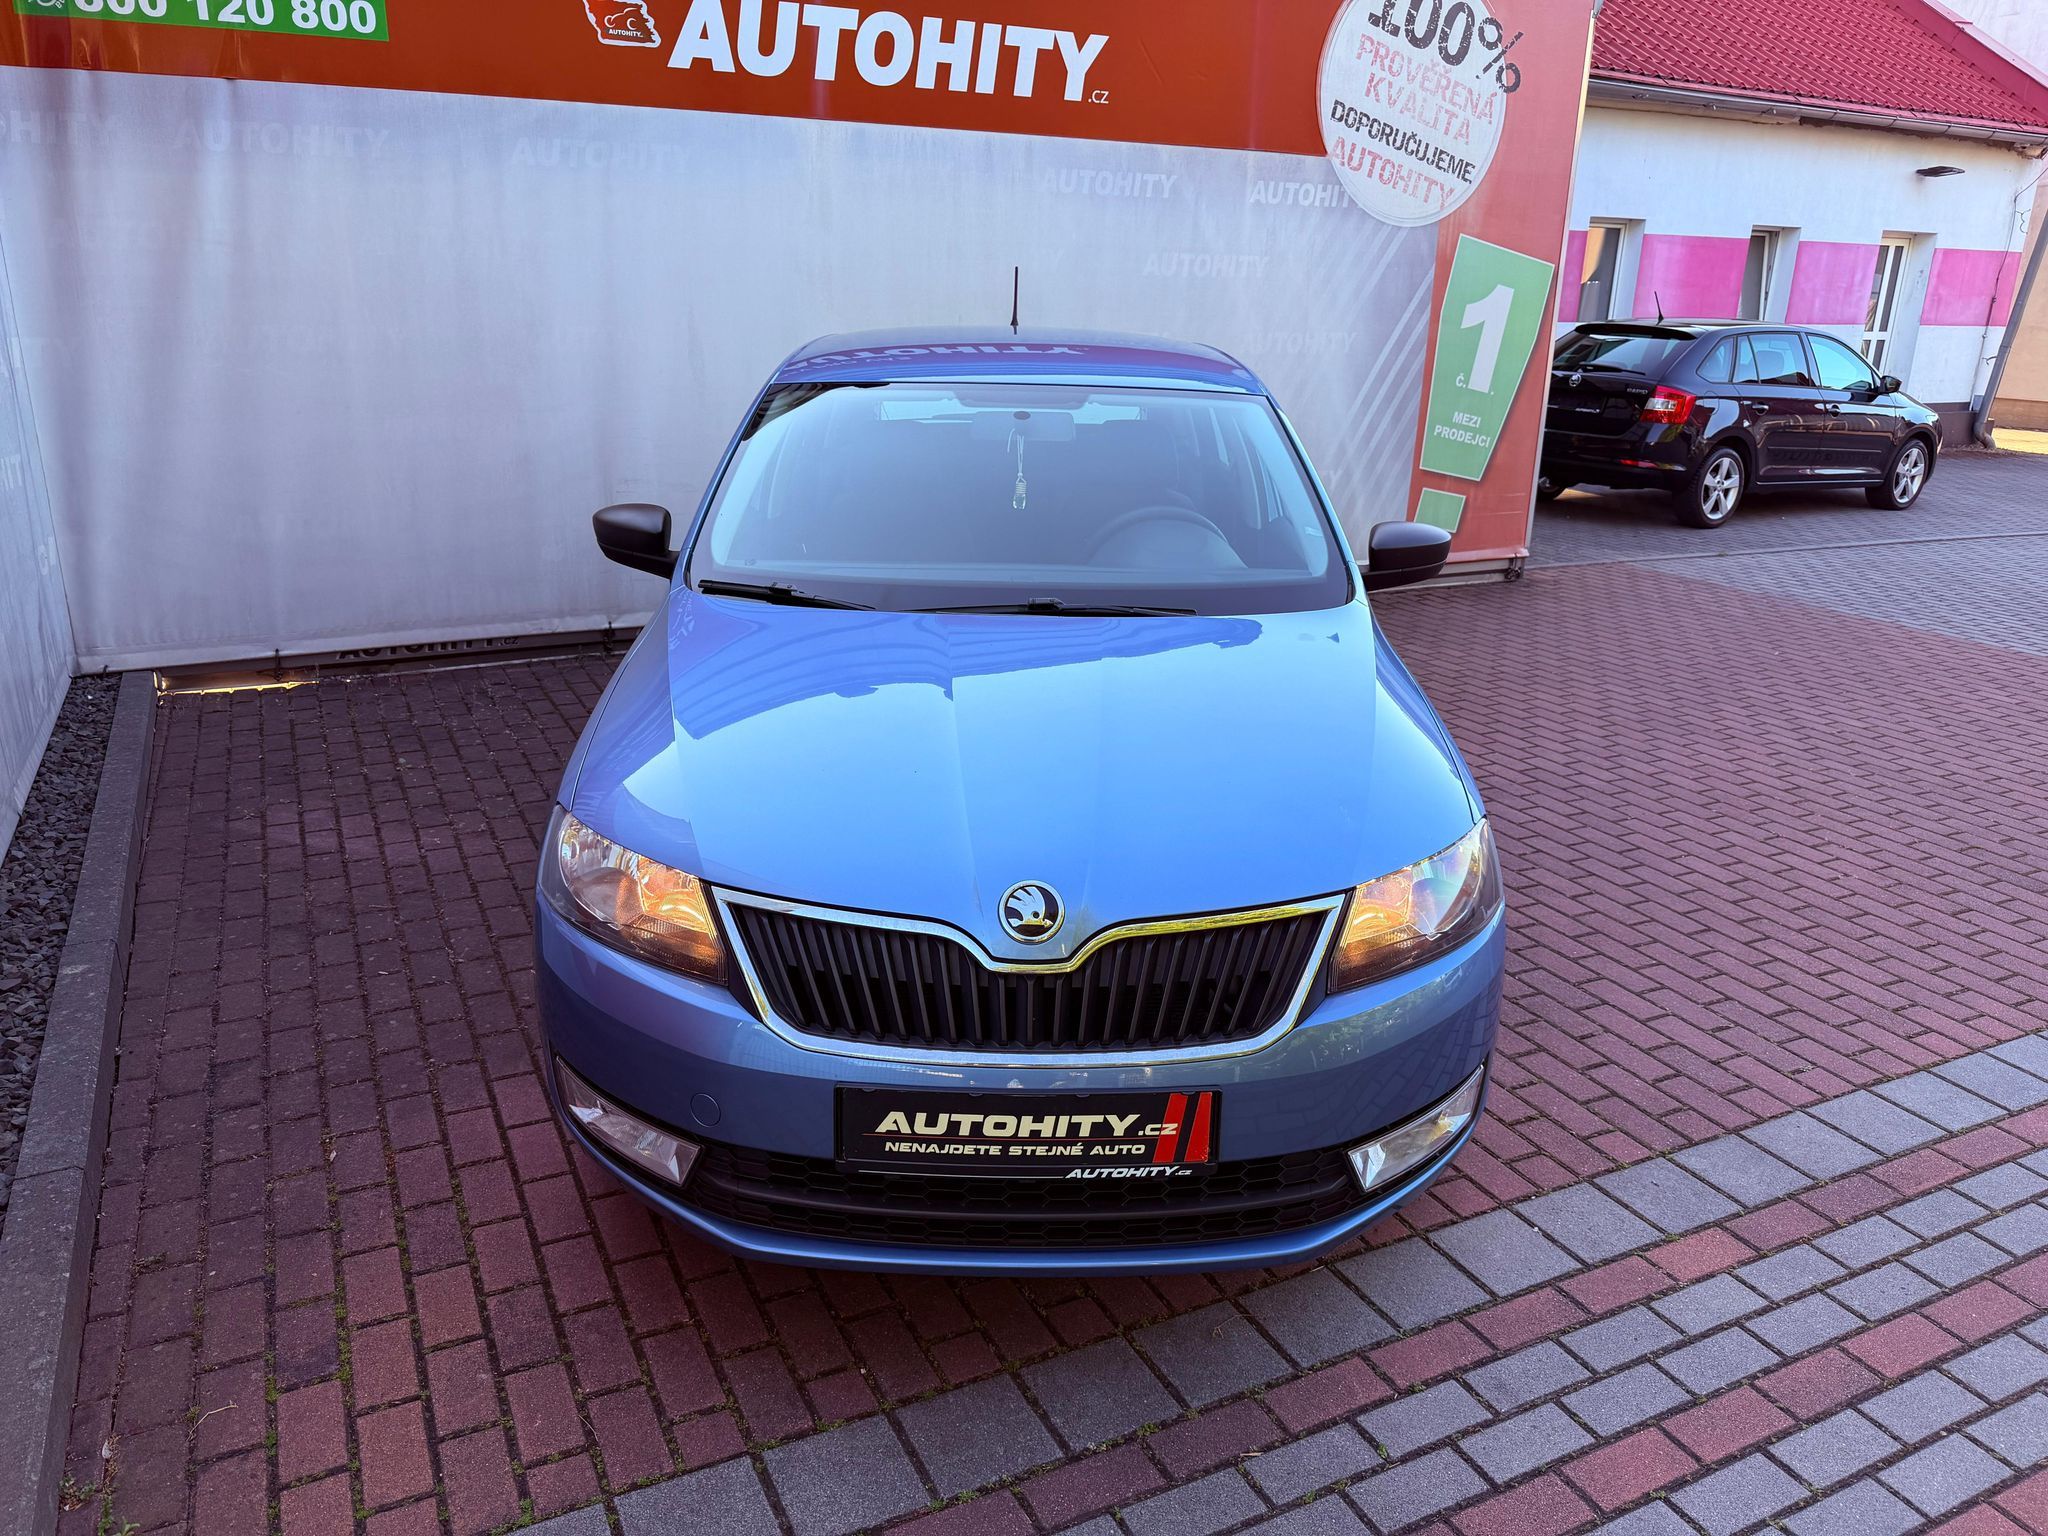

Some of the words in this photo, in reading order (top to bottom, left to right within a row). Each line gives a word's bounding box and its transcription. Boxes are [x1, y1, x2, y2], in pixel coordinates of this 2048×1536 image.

[186, 0, 274, 26] 120
[291, 0, 377, 34] 800
[1368, 0, 1524, 94] 100%
[1355, 33, 1498, 125] PROVĚŘENÁ
[1365, 72, 1470, 145] KVALITA
[1330, 99, 1477, 184] DOPORUČUJEME
[1042, 168, 1178, 199] AUTOHITY
[1329, 136, 1456, 211] AUTOHITY
[1249, 180, 1361, 208] AUTOHIT
[1142, 253, 1271, 278] AUTOHITY
[1452, 411, 1482, 429] MEZI
[1433, 424, 1492, 449] PRODEJCI
[885, 1141, 1002, 1156] NENAJDETE
[1008, 1142, 1084, 1156] STEJNÉ
[1089, 1144, 1146, 1156] AUTO
